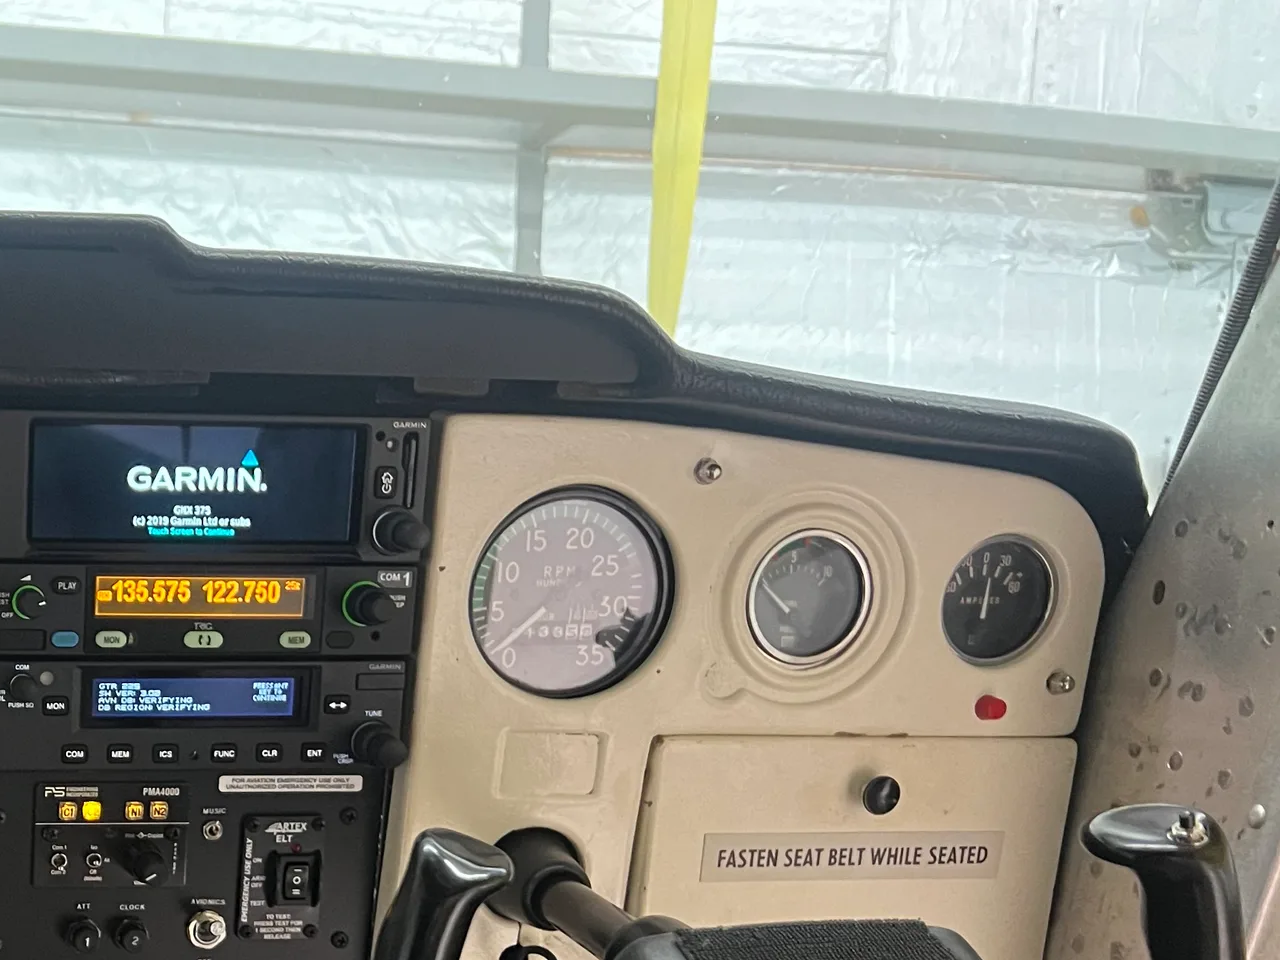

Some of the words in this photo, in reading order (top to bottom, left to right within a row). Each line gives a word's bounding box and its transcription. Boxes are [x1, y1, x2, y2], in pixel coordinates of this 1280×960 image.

[393, 421, 427, 429] GARMIN
[147, 516, 169, 526] 2019
[170, 516, 202, 527] Garmin
[203, 516, 218, 527] Ltd
[219, 518, 229, 527] or
[147, 527, 169, 536] Touch
[170, 527, 194, 536] Screen
[195, 527, 203, 536] to
[204, 527, 235, 536] Continue
[526, 530, 547, 552] 15
[566, 528, 594, 550] 20
[591, 555, 619, 576] 25
[497, 561, 520, 583] 10
[543, 565, 576, 578] RPM
[380, 573, 400, 581] COM
[403, 572, 410, 586] 1
[58, 582, 77, 590] PLAY
[112, 580, 191, 603] 135.575
[202, 580, 280, 604] 122.750
[492, 601, 505, 621] 5
[599, 596, 627, 617] 30
[194, 622, 213, 630] TRIG
[288, 636, 305, 644] MEM
[502, 647, 516, 668] 0
[575, 644, 604, 666] 35
[46, 702, 64, 710] MON
[65, 750, 84, 758] COM
[111, 750, 130, 758] MEM
[159, 750, 173, 758] ICS
[214, 750, 235, 758] FUNC
[262, 749, 278, 757] CLR
[307, 749, 322, 757] ENT
[142, 787, 180, 796] PMA4000
[153, 807, 166, 816] N2
[277, 822, 307, 831] ARTEX
[276, 835, 293, 843] ELT
[717, 849, 779, 868] FASTEN
[783, 848, 824, 868] SEAT
[828, 847, 865, 867] BELT
[870, 846, 923, 866] WHILE
[927, 845, 988, 865] SEATED
[241, 877, 250, 922] EMERGENCY
[246, 837, 254, 859] ONLY
